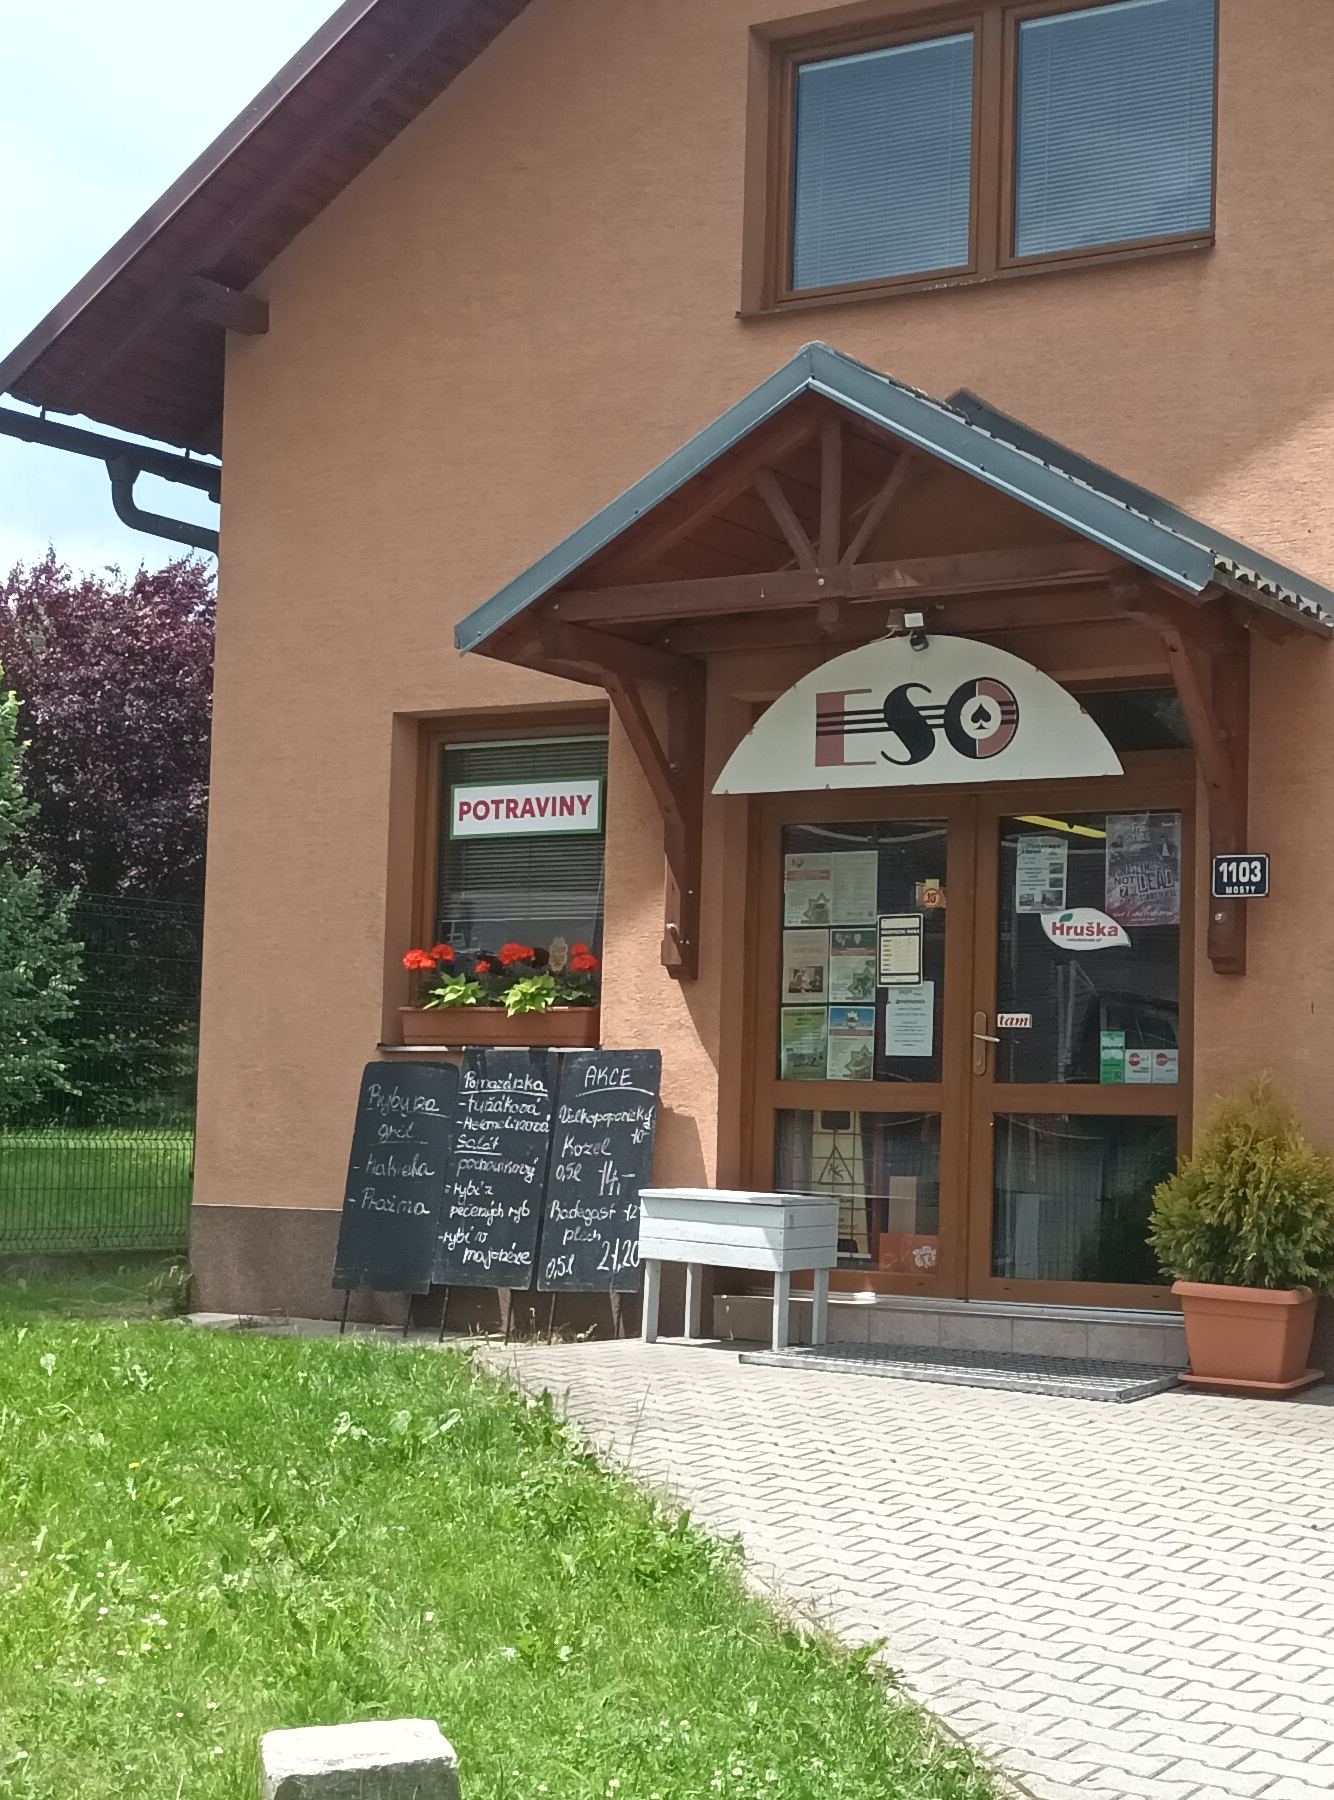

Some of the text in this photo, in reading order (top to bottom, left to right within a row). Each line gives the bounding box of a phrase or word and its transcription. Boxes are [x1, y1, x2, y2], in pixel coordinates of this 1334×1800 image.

[815, 677, 1019, 767] ESO
[458, 794, 593, 822] POTRAVINY
[1114, 868, 1176, 893] NOT DEAD
[1218, 861, 1262, 883] 1103
[1225, 885, 1256, 894] MOSTY
[1051, 922, 1119, 937] Hruška
[584, 1065, 633, 1088] AKCE
[561, 1132, 612, 1158] Kozel
[508, 1199, 531, 1224] ryb
[562, 1225, 602, 1246] plech
[596, 1237, 640, 1274] 21,20
